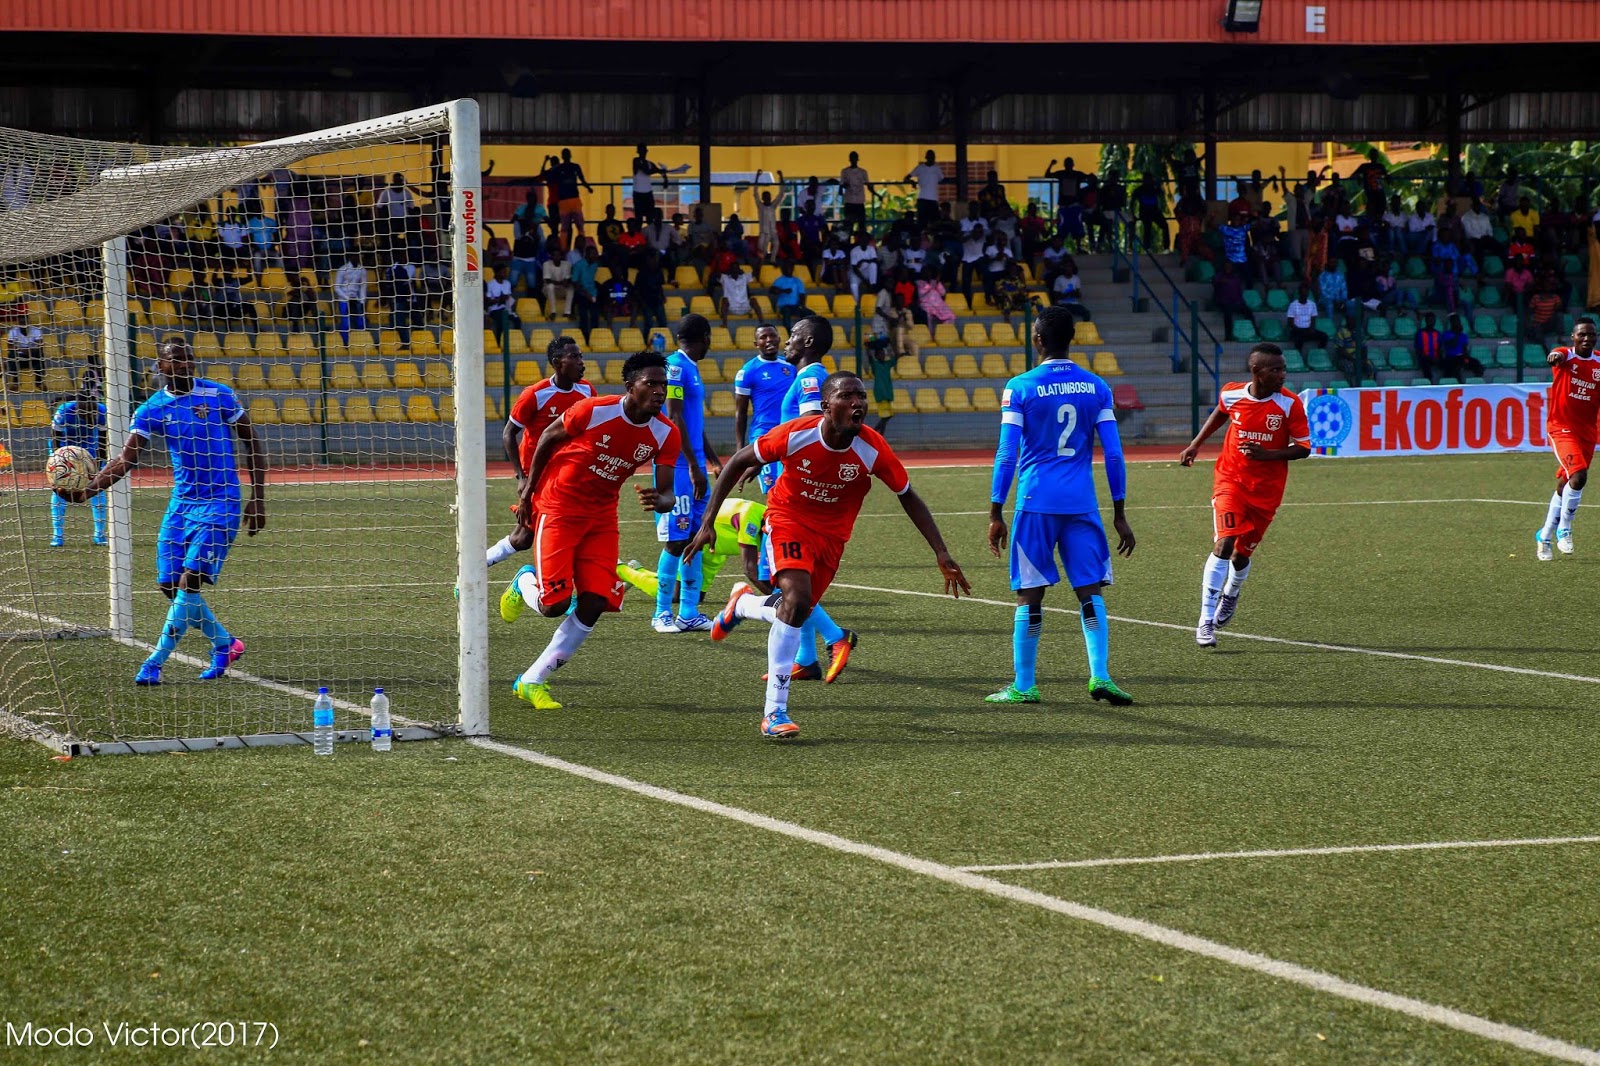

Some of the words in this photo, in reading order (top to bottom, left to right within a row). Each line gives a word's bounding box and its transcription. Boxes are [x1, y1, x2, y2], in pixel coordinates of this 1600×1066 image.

[1306, 6, 1326, 33] E
[462, 190, 477, 244] polytan
[1037, 382, 1096, 397] OLATUNBOSUN
[1570, 377, 1597, 390] SPARTAN
[674, 386, 683, 398] C
[1568, 393, 1592, 401] AGEGE
[1057, 403, 1077, 457] 2
[1237, 430, 1273, 441] SPARTAN
[597, 453, 634, 469] SPARTAN
[588, 464, 619, 481] AGEGE
[801, 477, 845, 489] SPARTAN
[800, 491, 838, 503] AGEGE
[673, 495, 690, 516] 30
[1220, 512, 1235, 528] 10
[780, 541, 802, 559] 18
